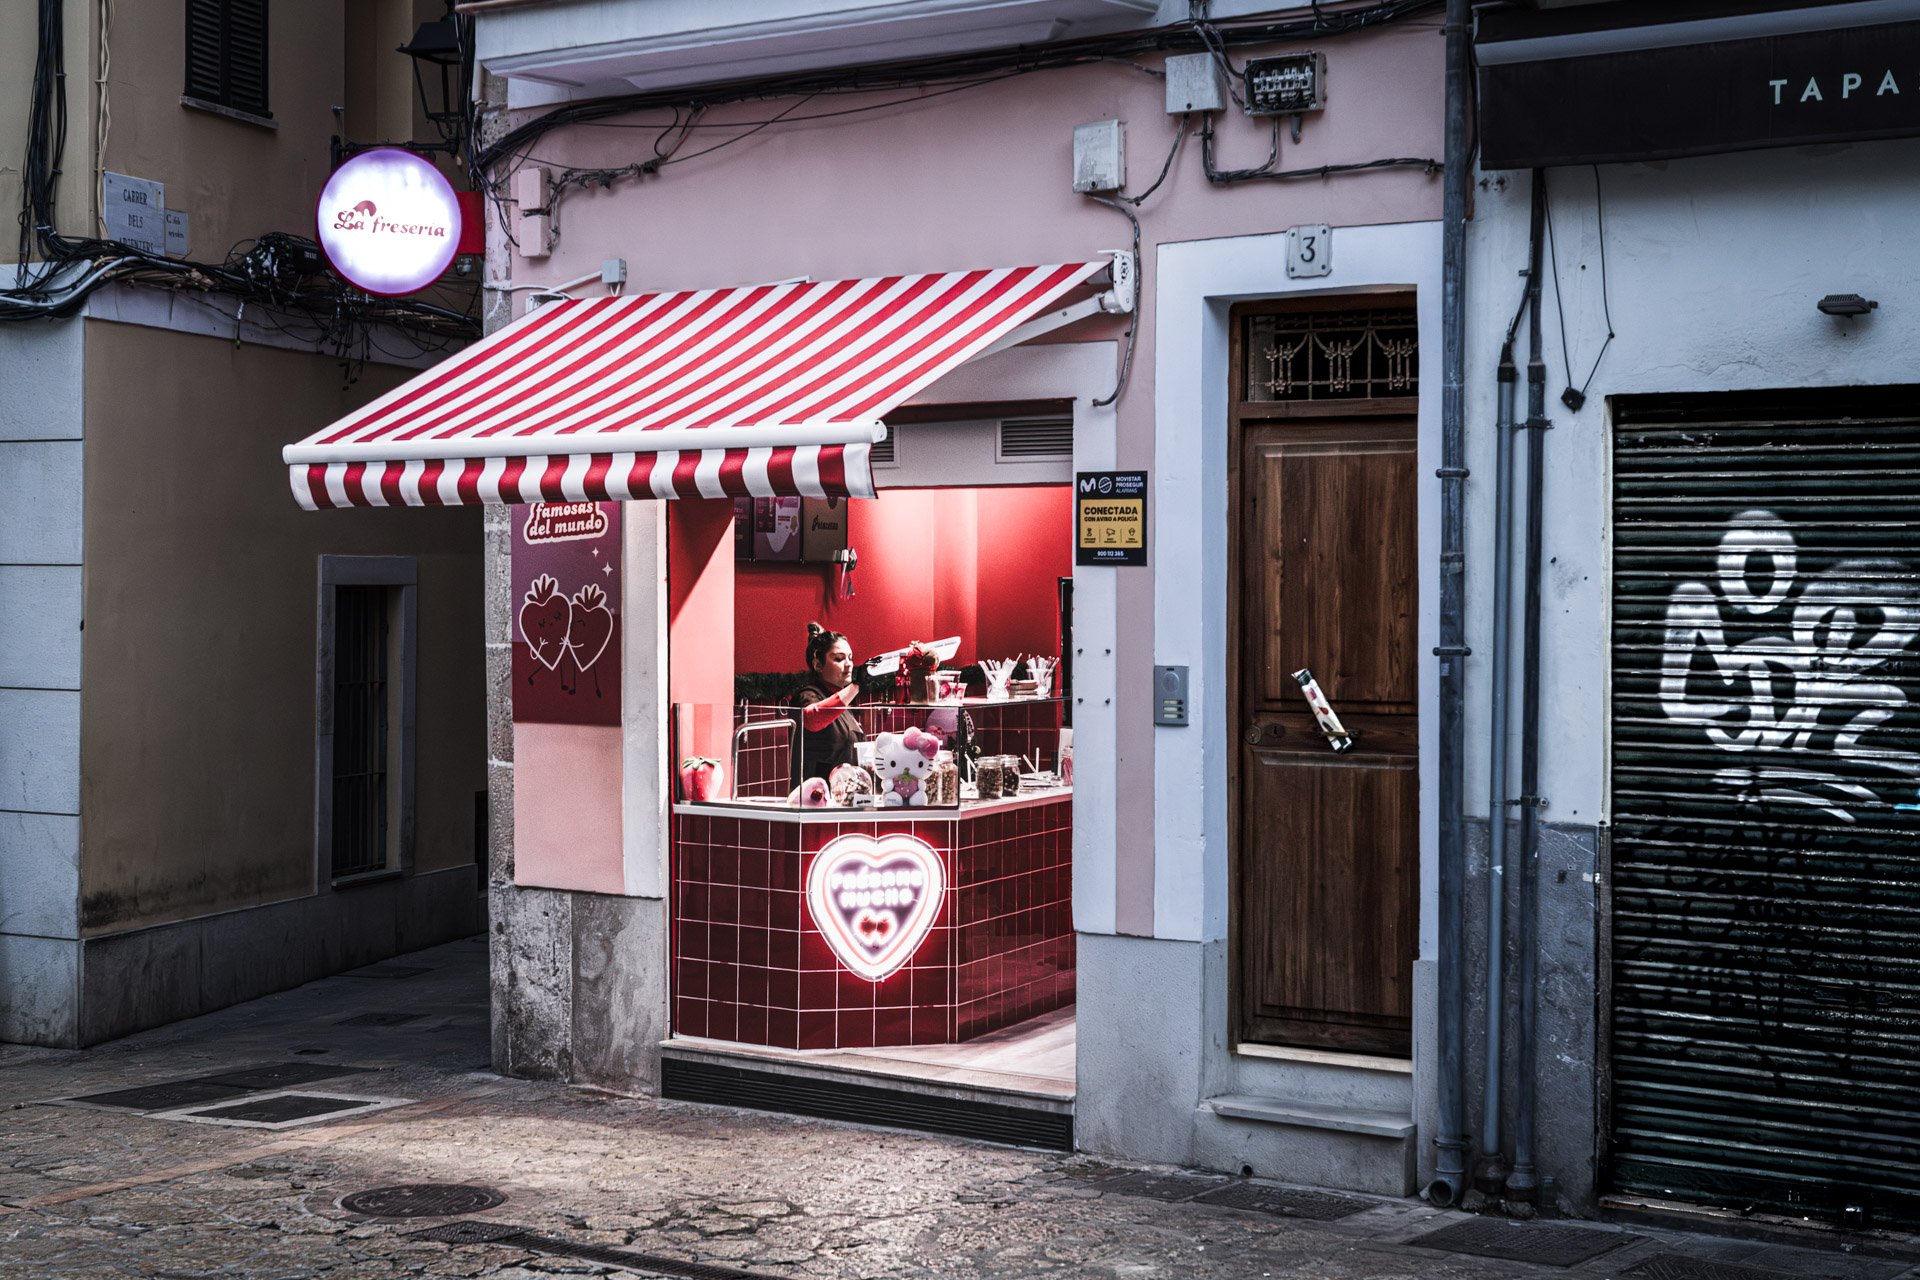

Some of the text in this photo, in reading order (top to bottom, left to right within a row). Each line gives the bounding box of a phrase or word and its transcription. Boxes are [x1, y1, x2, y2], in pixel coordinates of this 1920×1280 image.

[1769, 69, 1920, 105] TAPA
[123, 188, 148, 206] CARRER
[128, 214, 144, 229] DELS
[333, 210, 365, 231] La
[1300, 236, 1316, 263] 3
[536, 502, 594, 521] famosas
[1084, 506, 1138, 515] CONECTADA
[529, 514, 602, 537] del mundo
[840, 889, 913, 908] MUCHO
